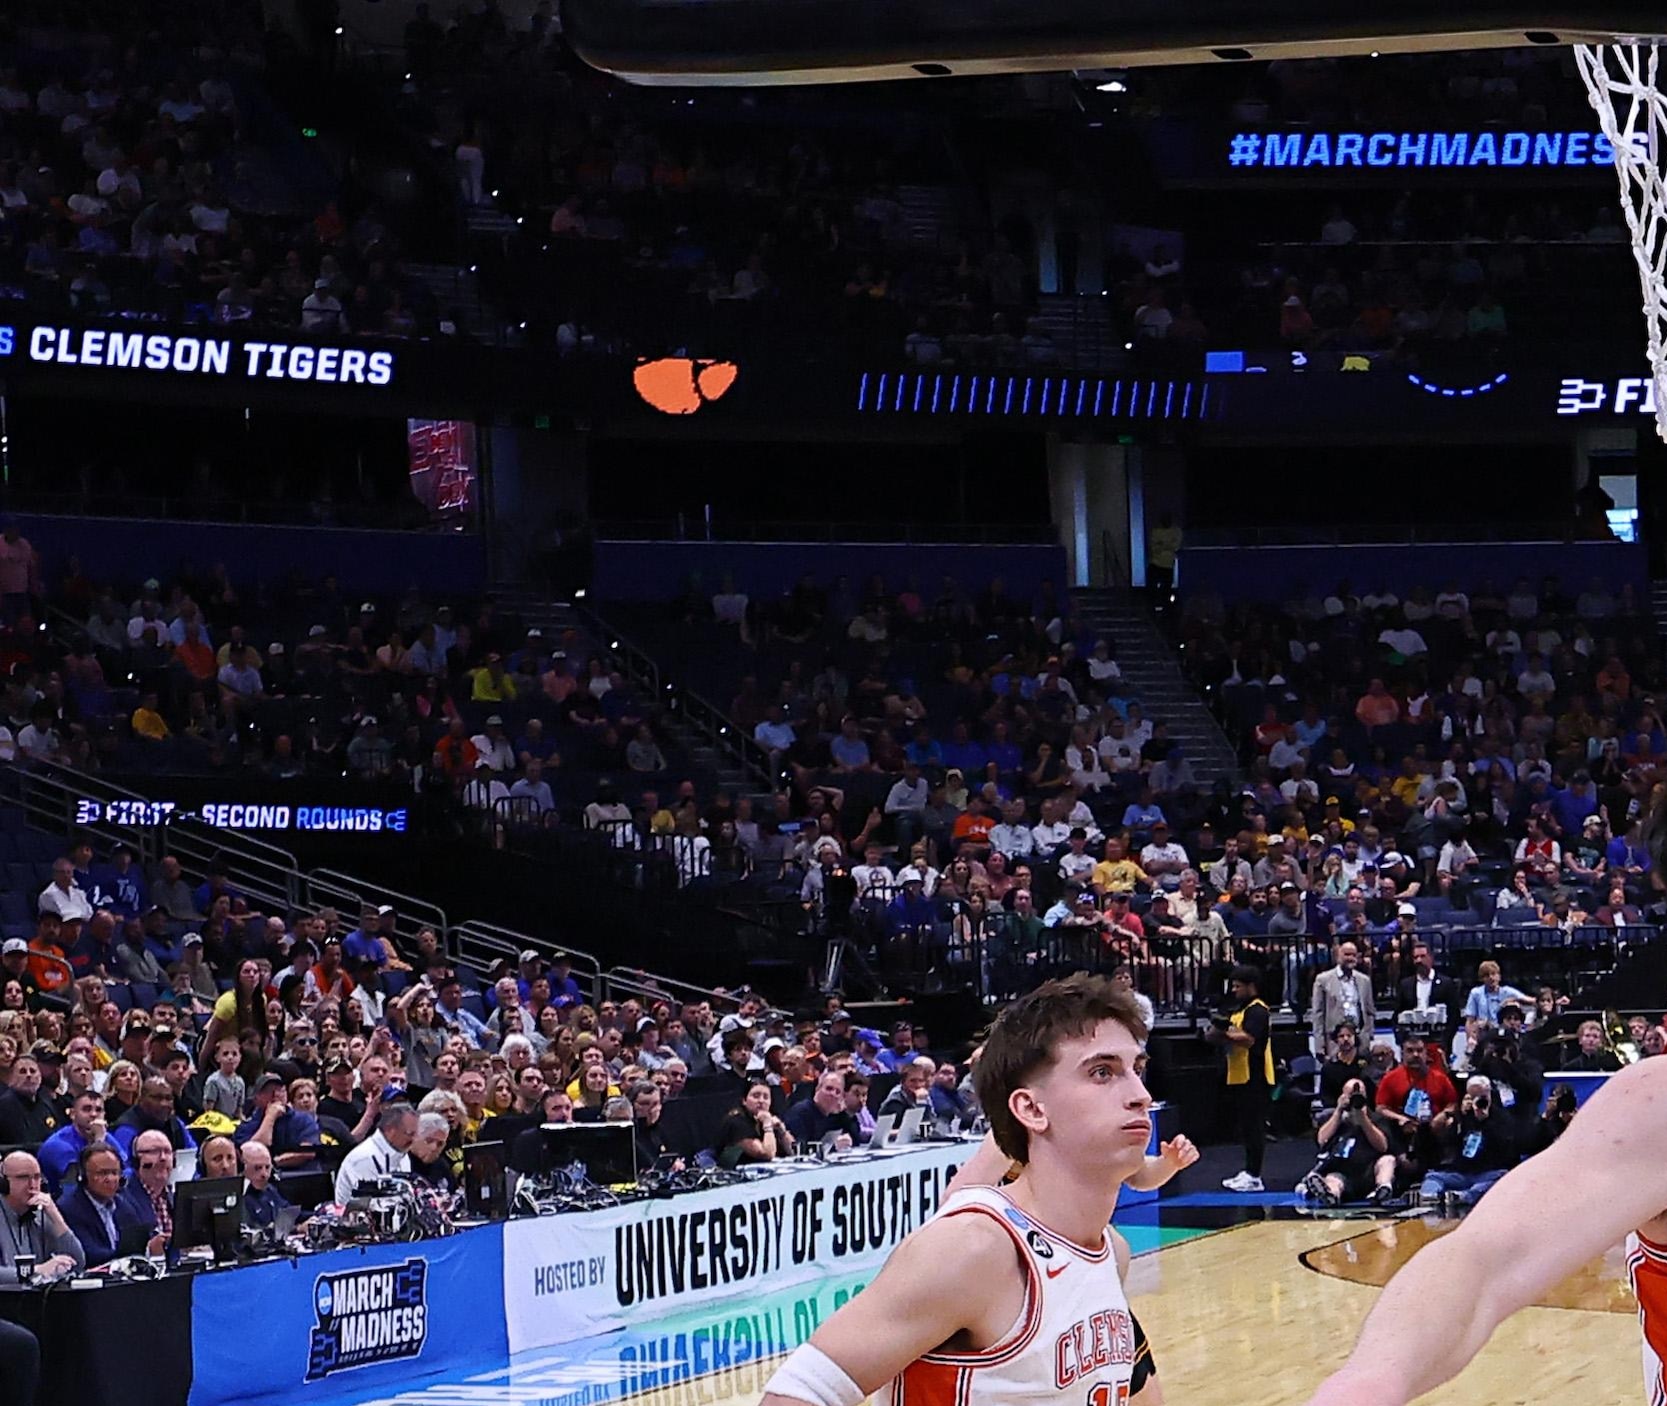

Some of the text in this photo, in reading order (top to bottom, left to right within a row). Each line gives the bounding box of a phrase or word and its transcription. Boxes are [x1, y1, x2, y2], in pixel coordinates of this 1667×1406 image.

[0, 326, 393, 385] S CLEMSON TIGERS
[106, 801, 383, 831] FIRST SECOND ROUNDS
[534, 1262, 588, 1297] HOSTED
[588, 1255, 607, 1284] BY
[613, 1195, 785, 1307] UNIVERSITY
[791, 1187, 824, 1265] OF
[832, 1171, 912, 1258] SOUTH
[332, 1271, 394, 1317] MARCH
[340, 1304, 425, 1354] MADNESS
